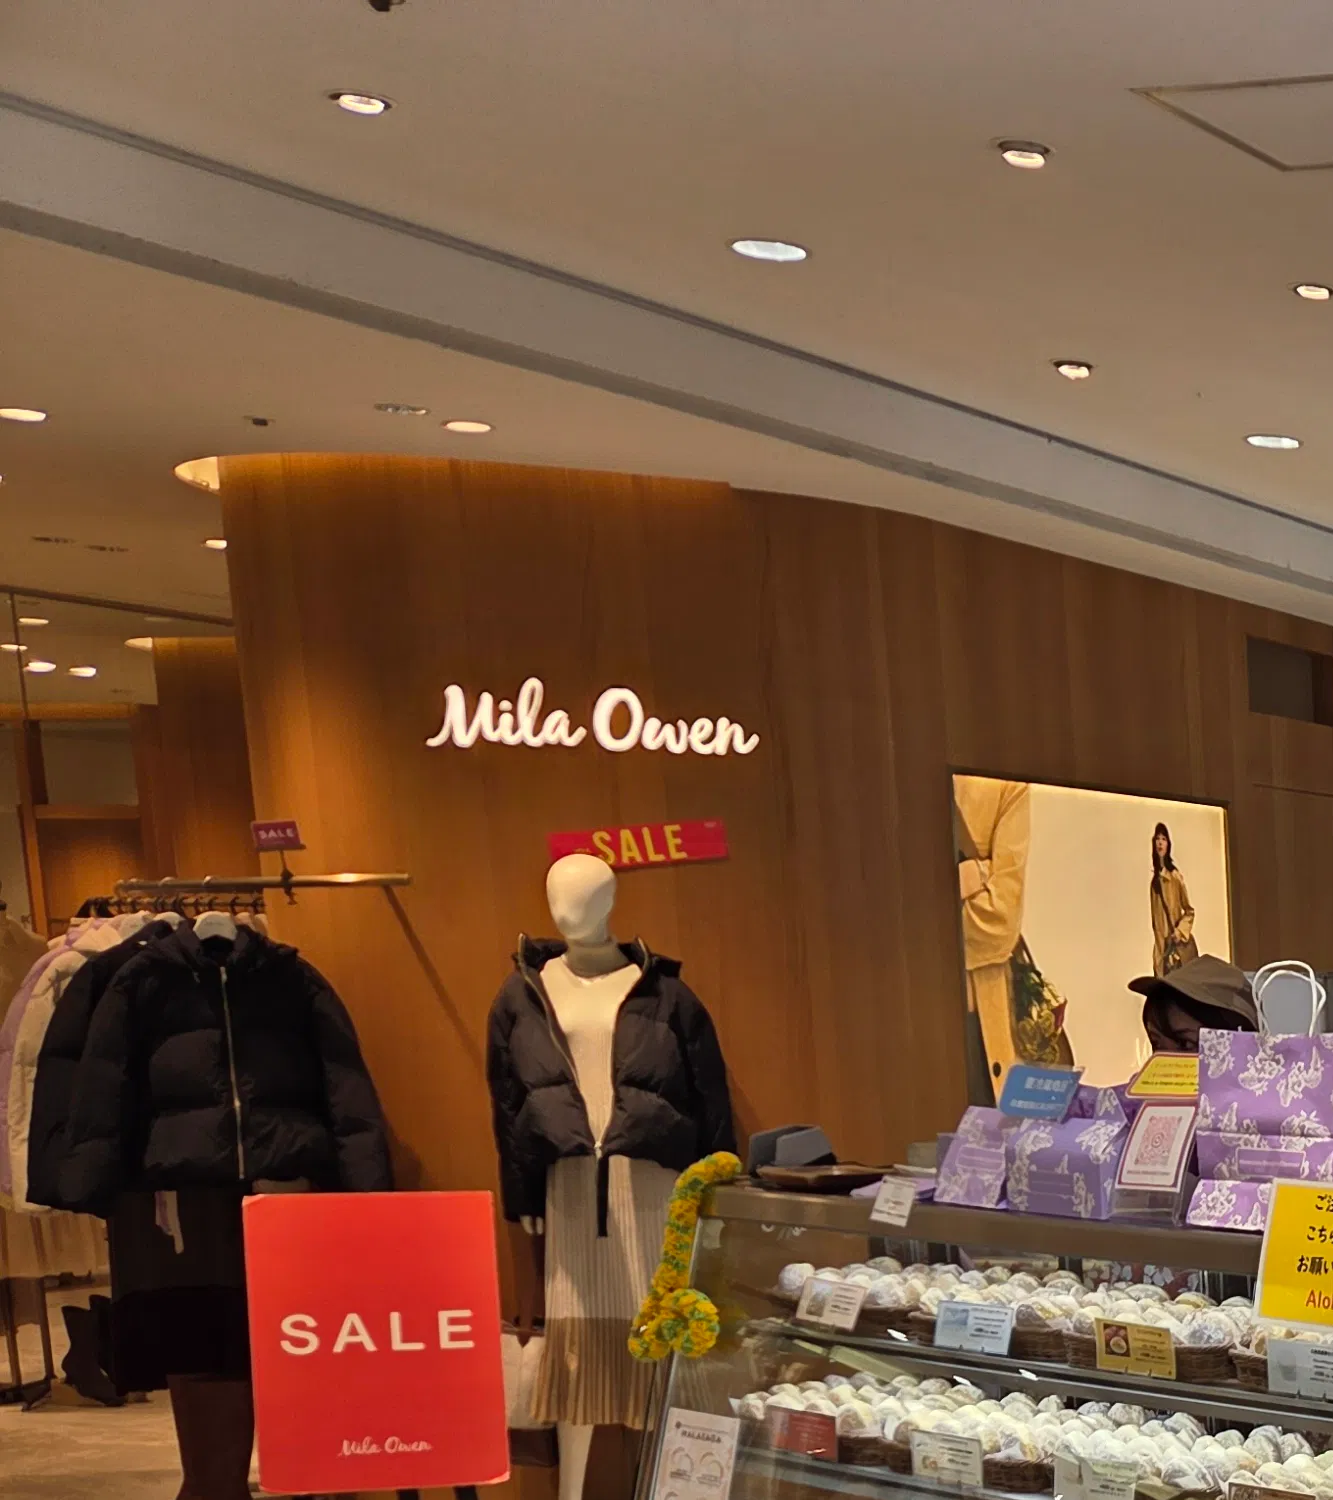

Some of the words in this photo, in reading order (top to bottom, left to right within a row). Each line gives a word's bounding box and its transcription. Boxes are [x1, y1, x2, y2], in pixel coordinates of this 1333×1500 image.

[426, 677, 587, 748] Mila
[593, 687, 760, 756] Owen
[592, 824, 688, 865] SALE
[280, 1309, 475, 1355] SALE
[338, 1437, 381, 1457] Mila
[384, 1436, 432, 1454] Owen
